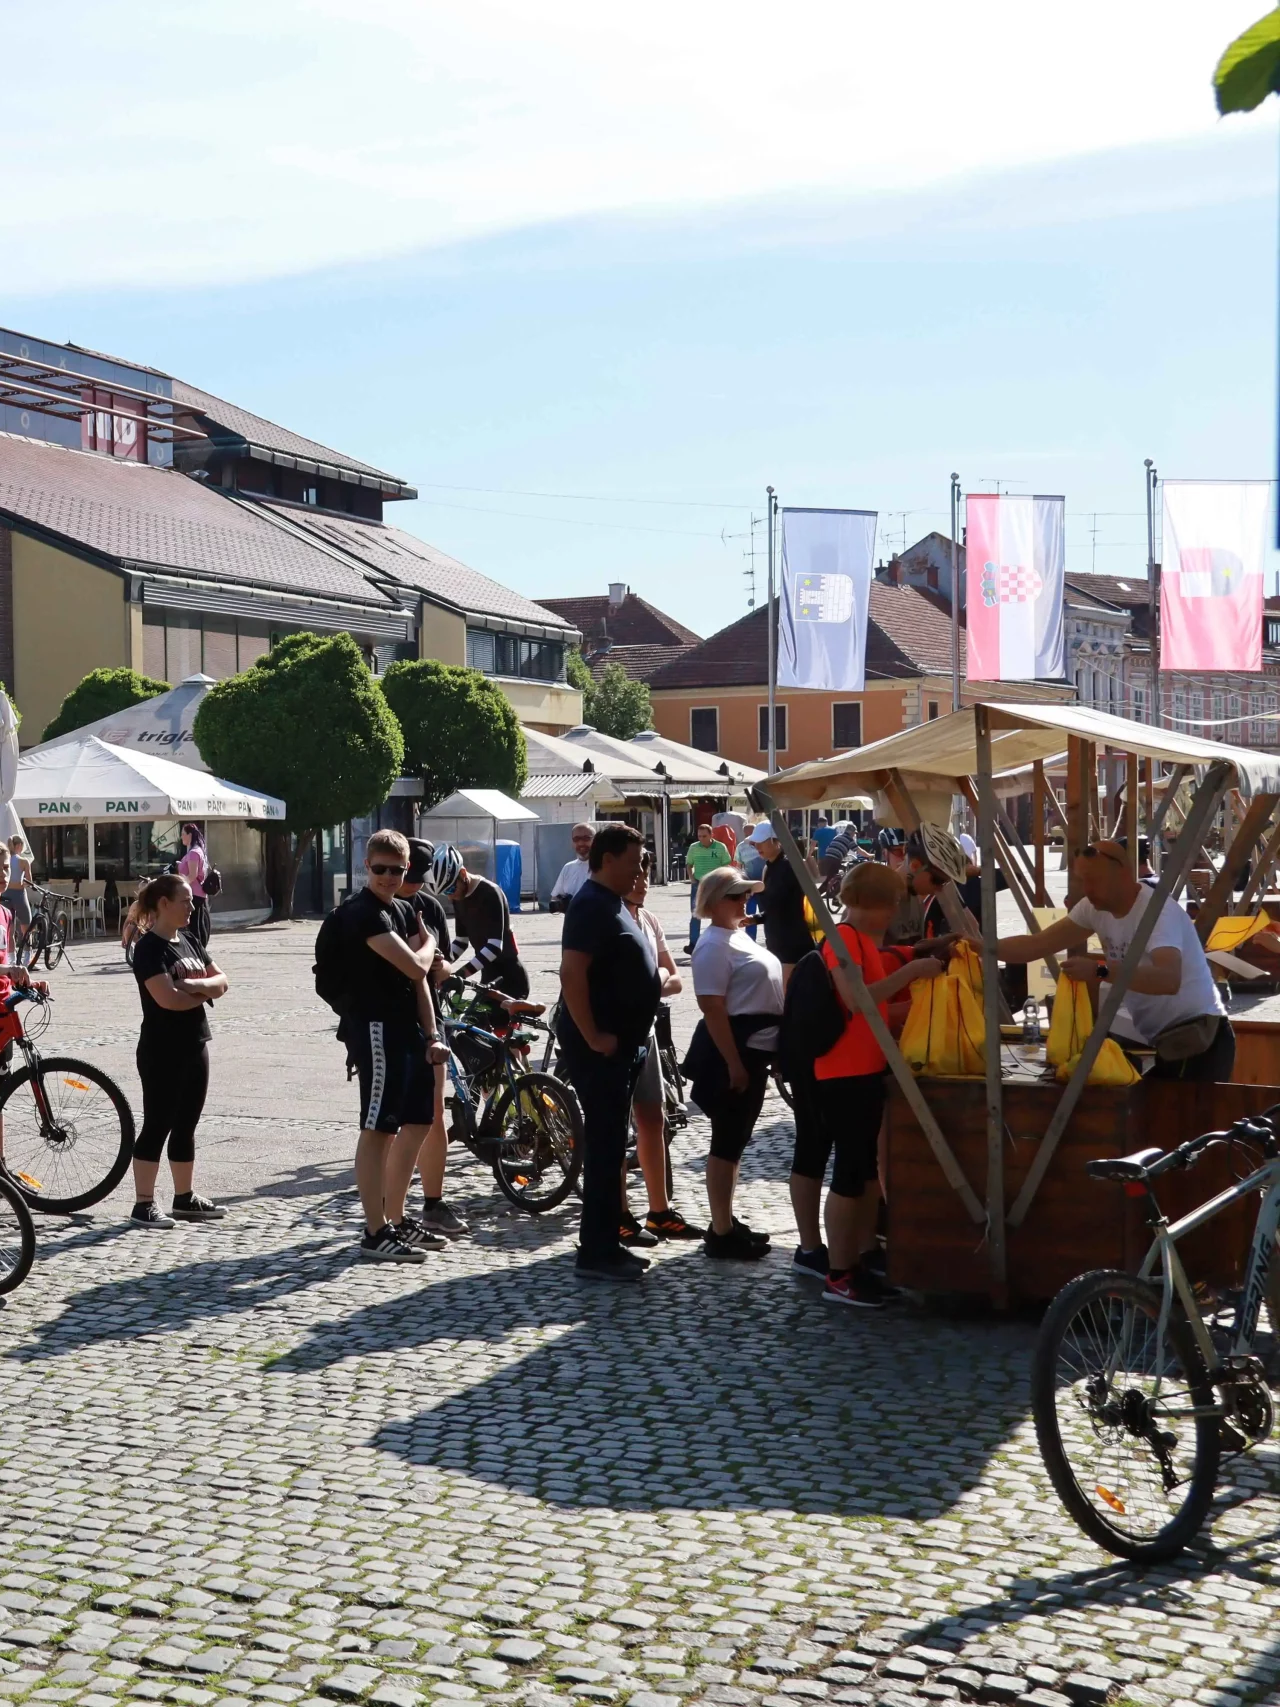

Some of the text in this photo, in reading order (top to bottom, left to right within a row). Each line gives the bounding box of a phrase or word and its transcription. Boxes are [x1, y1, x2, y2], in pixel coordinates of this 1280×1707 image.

[38, 802, 70, 813] PAN
[105, 801, 138, 812] PAN
[178, 800, 192, 811] PAN
[262, 804, 275, 816] PAN
